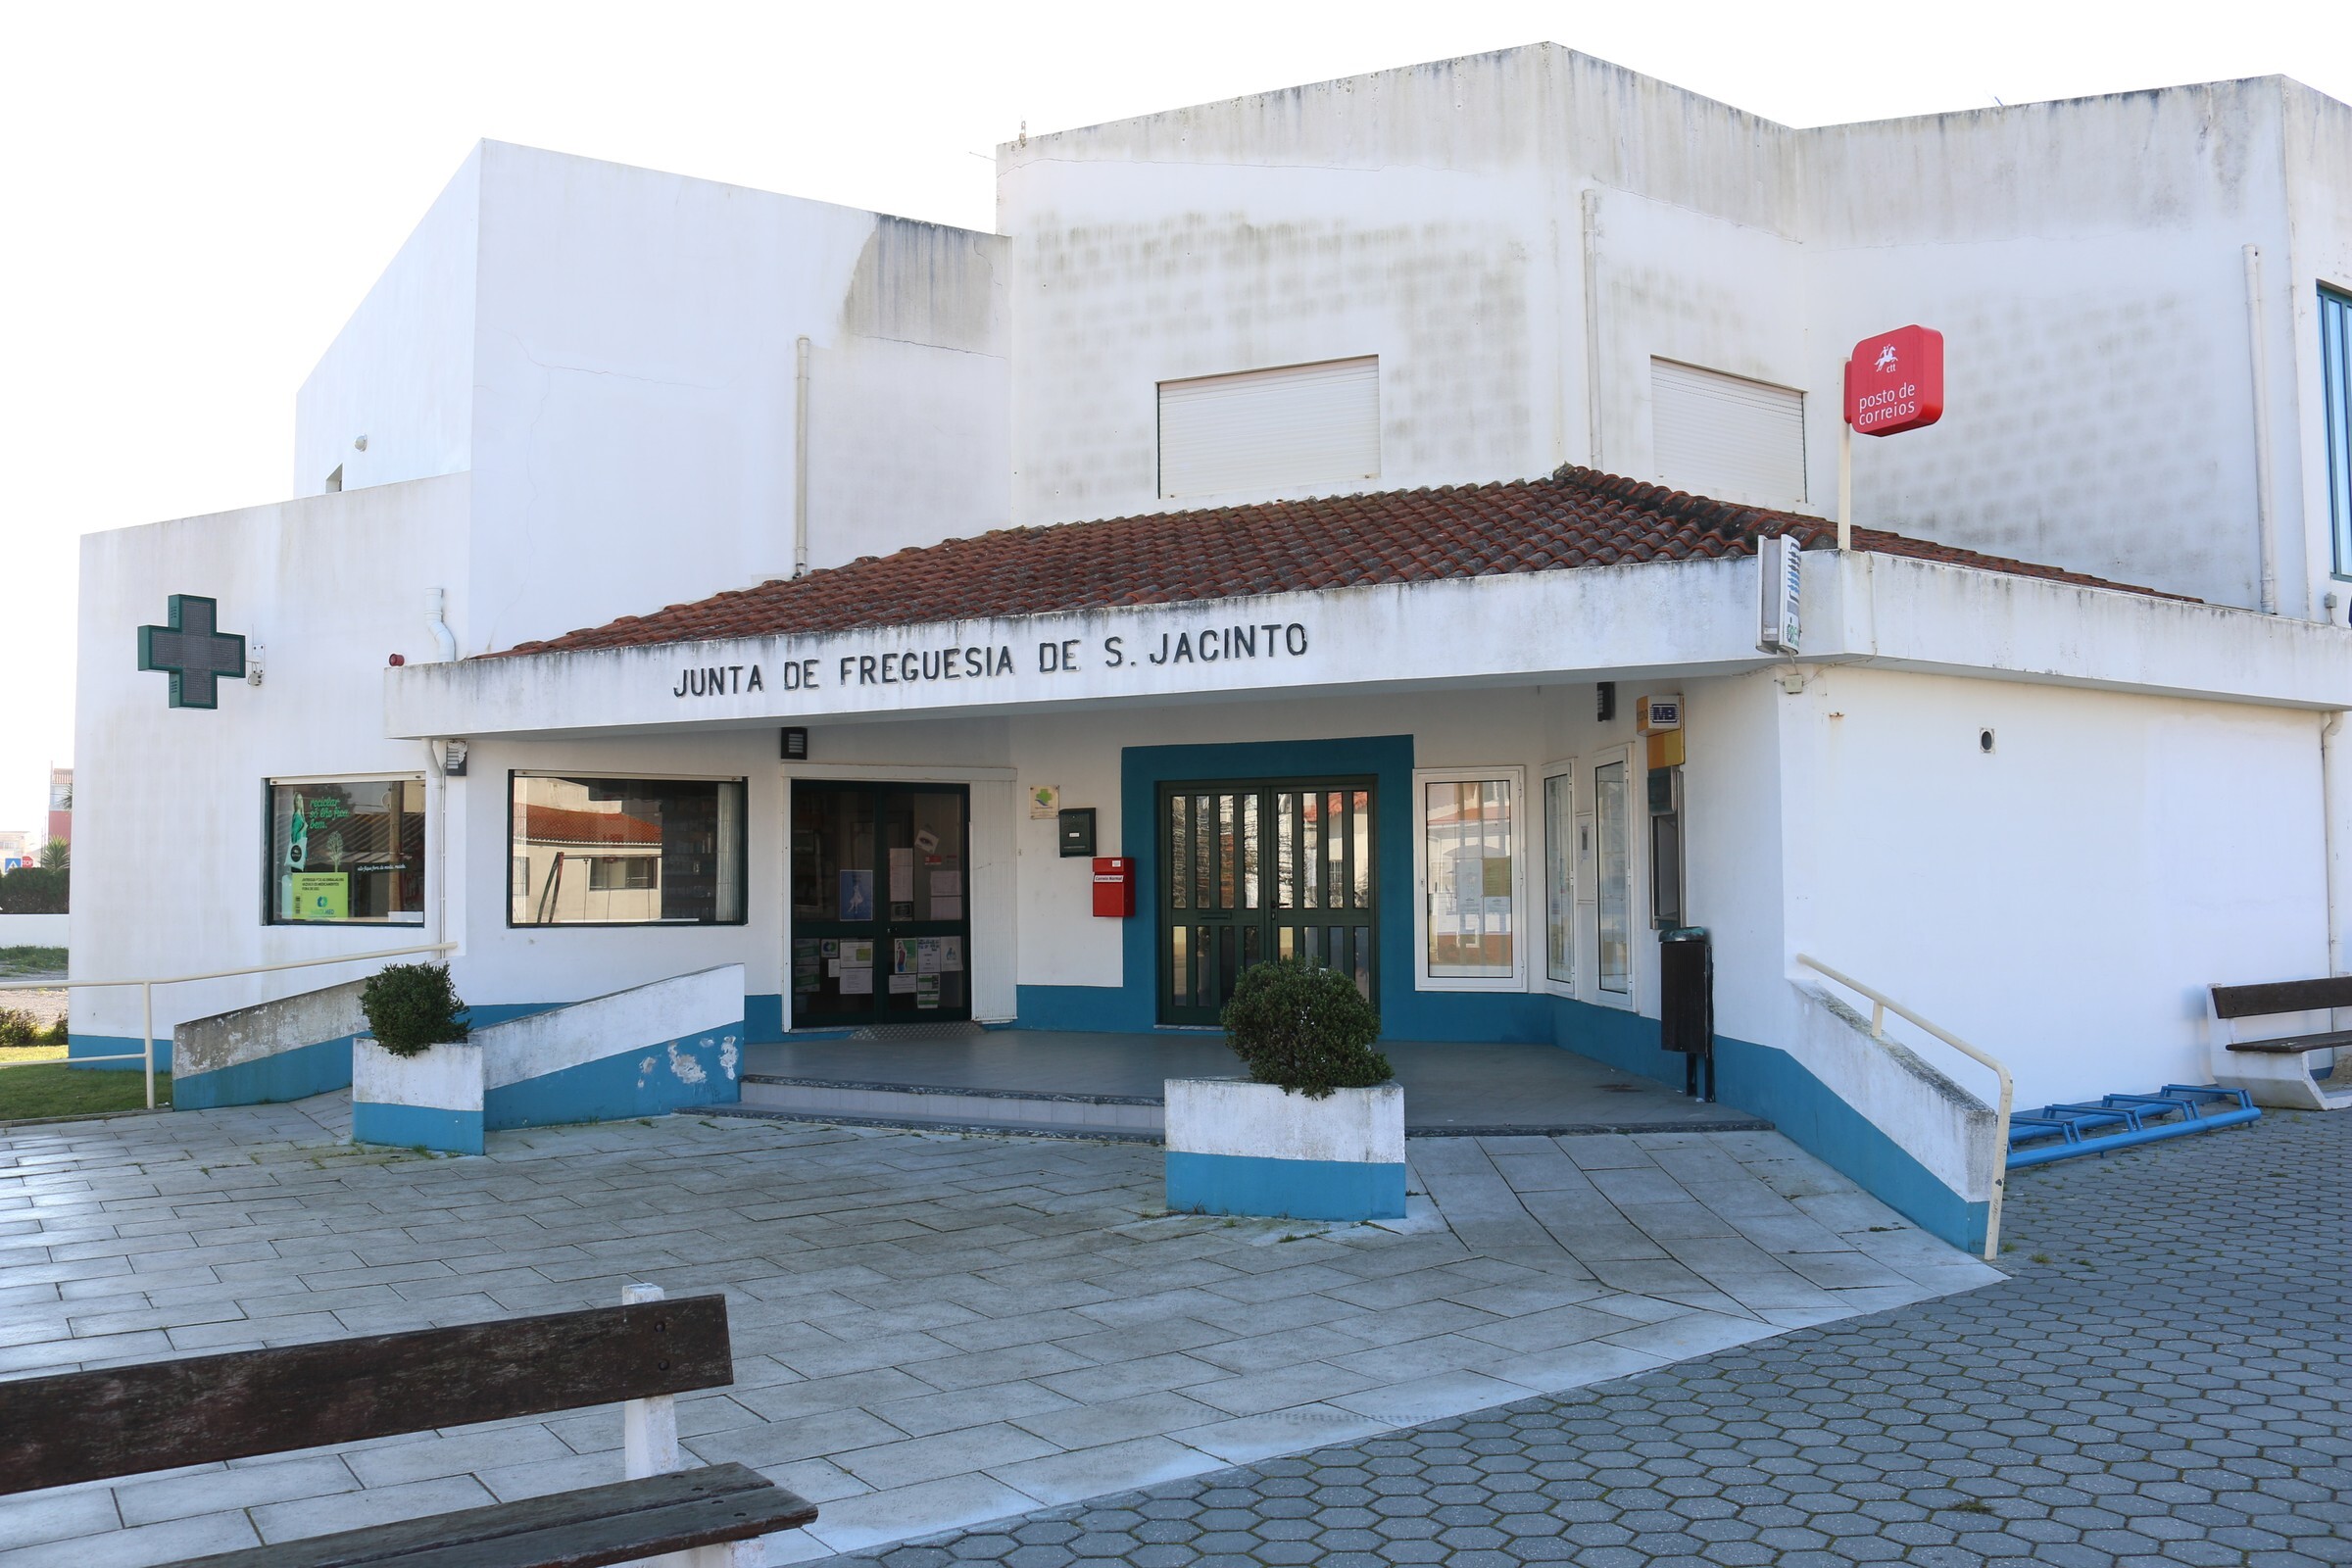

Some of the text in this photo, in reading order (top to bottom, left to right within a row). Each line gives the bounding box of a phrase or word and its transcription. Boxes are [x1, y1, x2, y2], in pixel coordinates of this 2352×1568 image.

[1886, 364, 1896, 373] ctt
[1859, 382, 1916, 414] posto de
[1859, 401, 1915, 425] correios
[673, 622, 1308, 699] JUNTA DE FREGUESIA DE S. JACINTO
